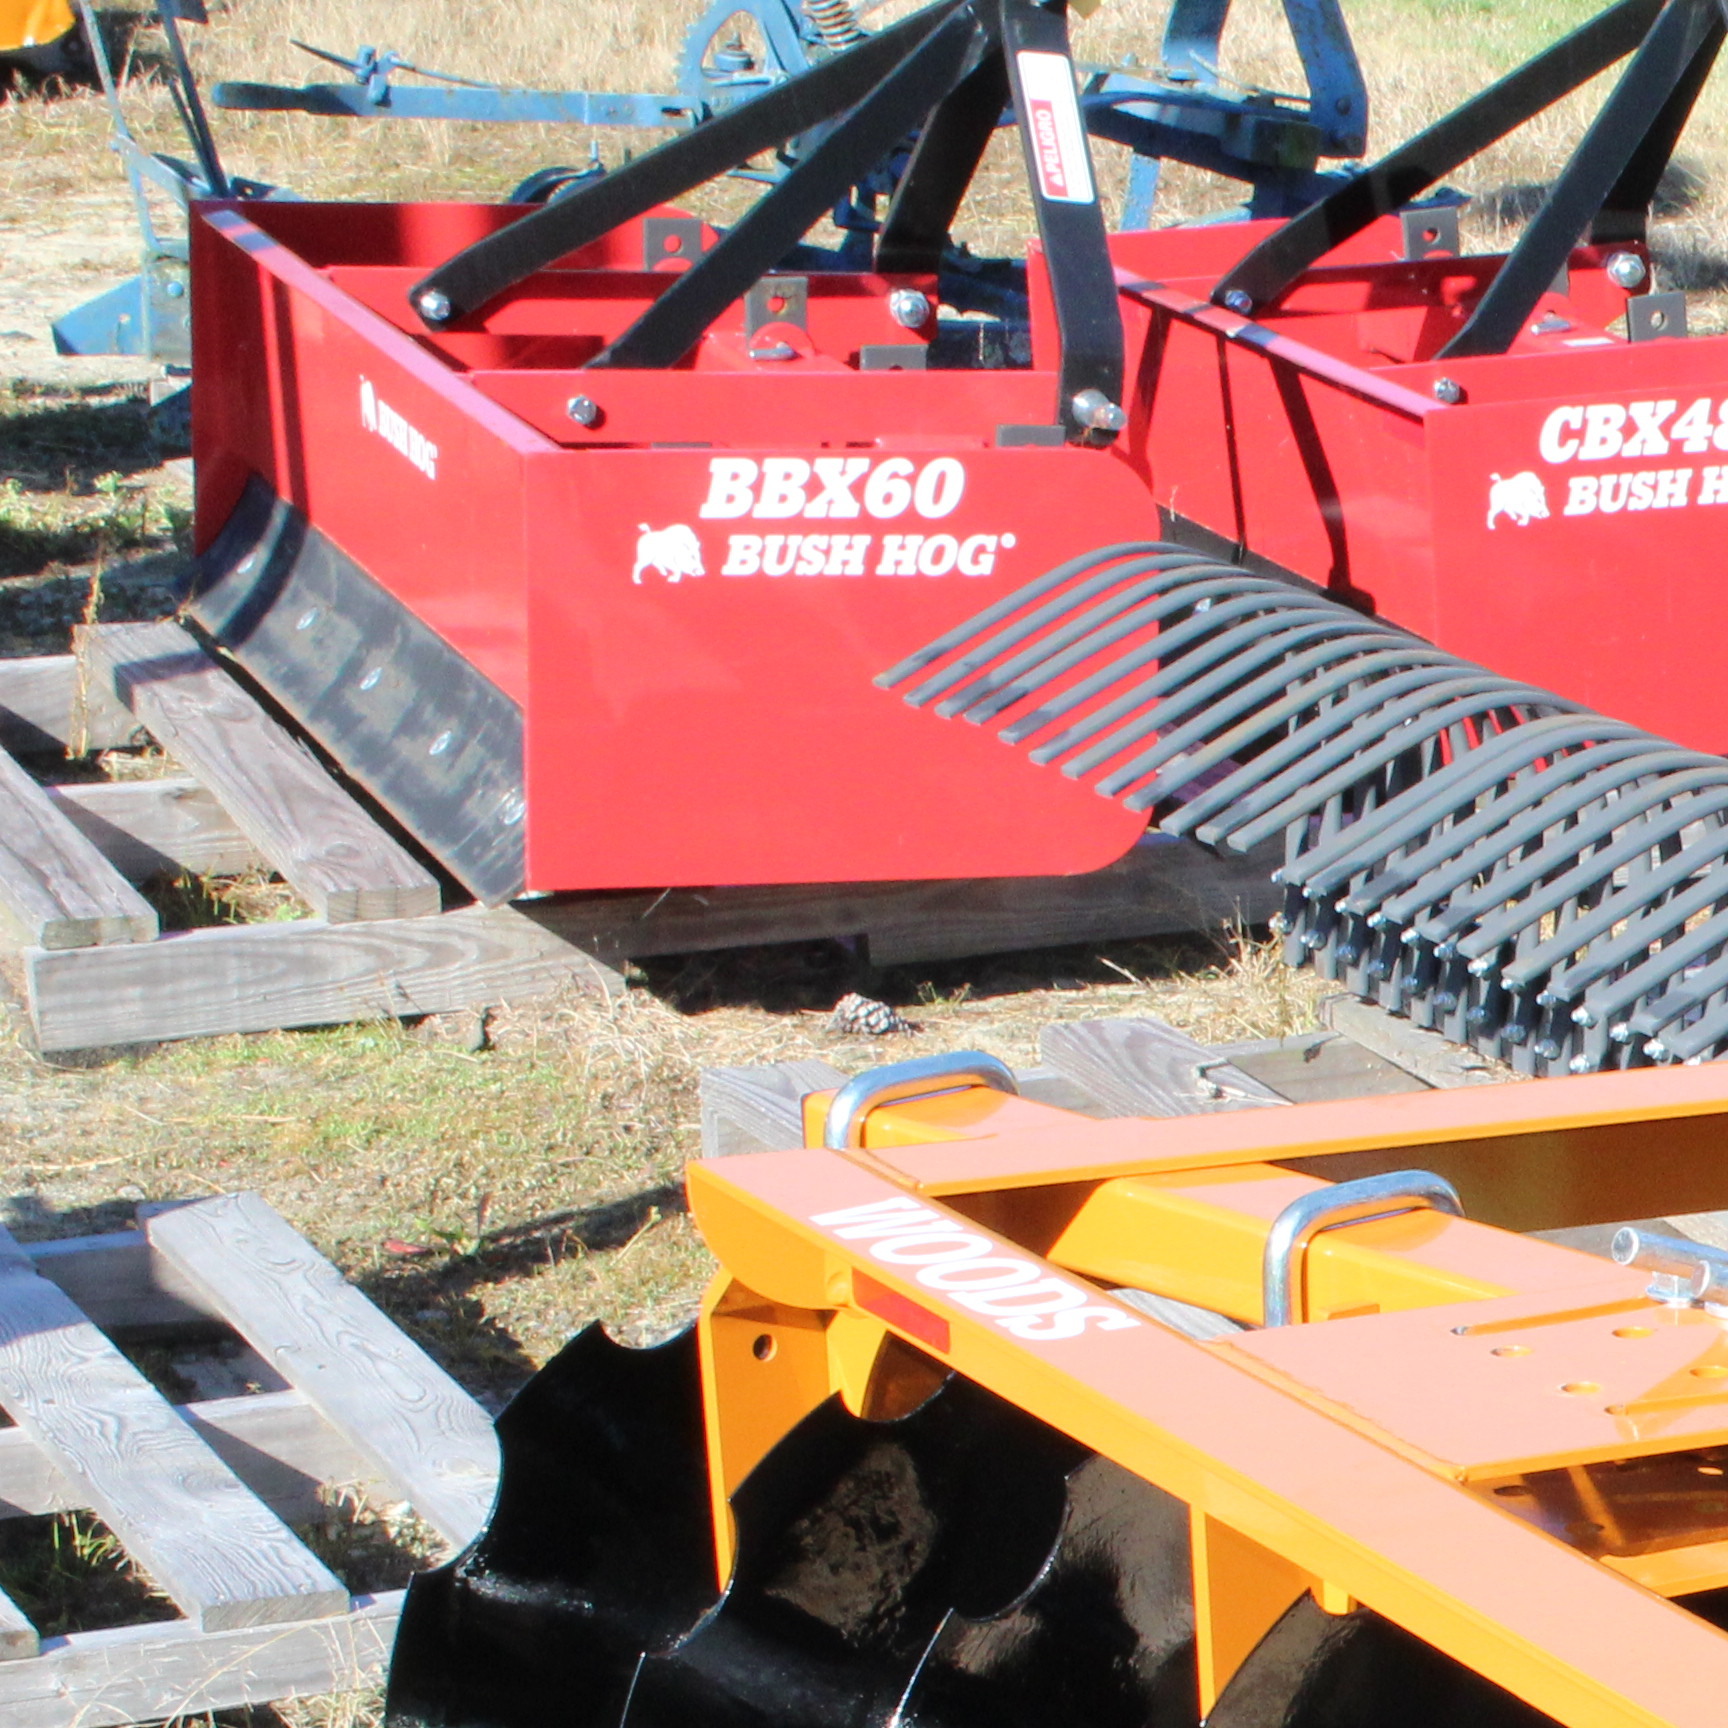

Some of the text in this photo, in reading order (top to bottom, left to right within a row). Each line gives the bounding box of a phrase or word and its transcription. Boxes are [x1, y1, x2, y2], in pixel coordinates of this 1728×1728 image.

[1035, 109, 1062, 174] PELIGRO
[699, 457, 965, 520] BBX60
[1564, 469, 1692, 516] BUSH
[722, 534, 870, 577] BUSH
[808, 1196, 1142, 1341] WOODS
